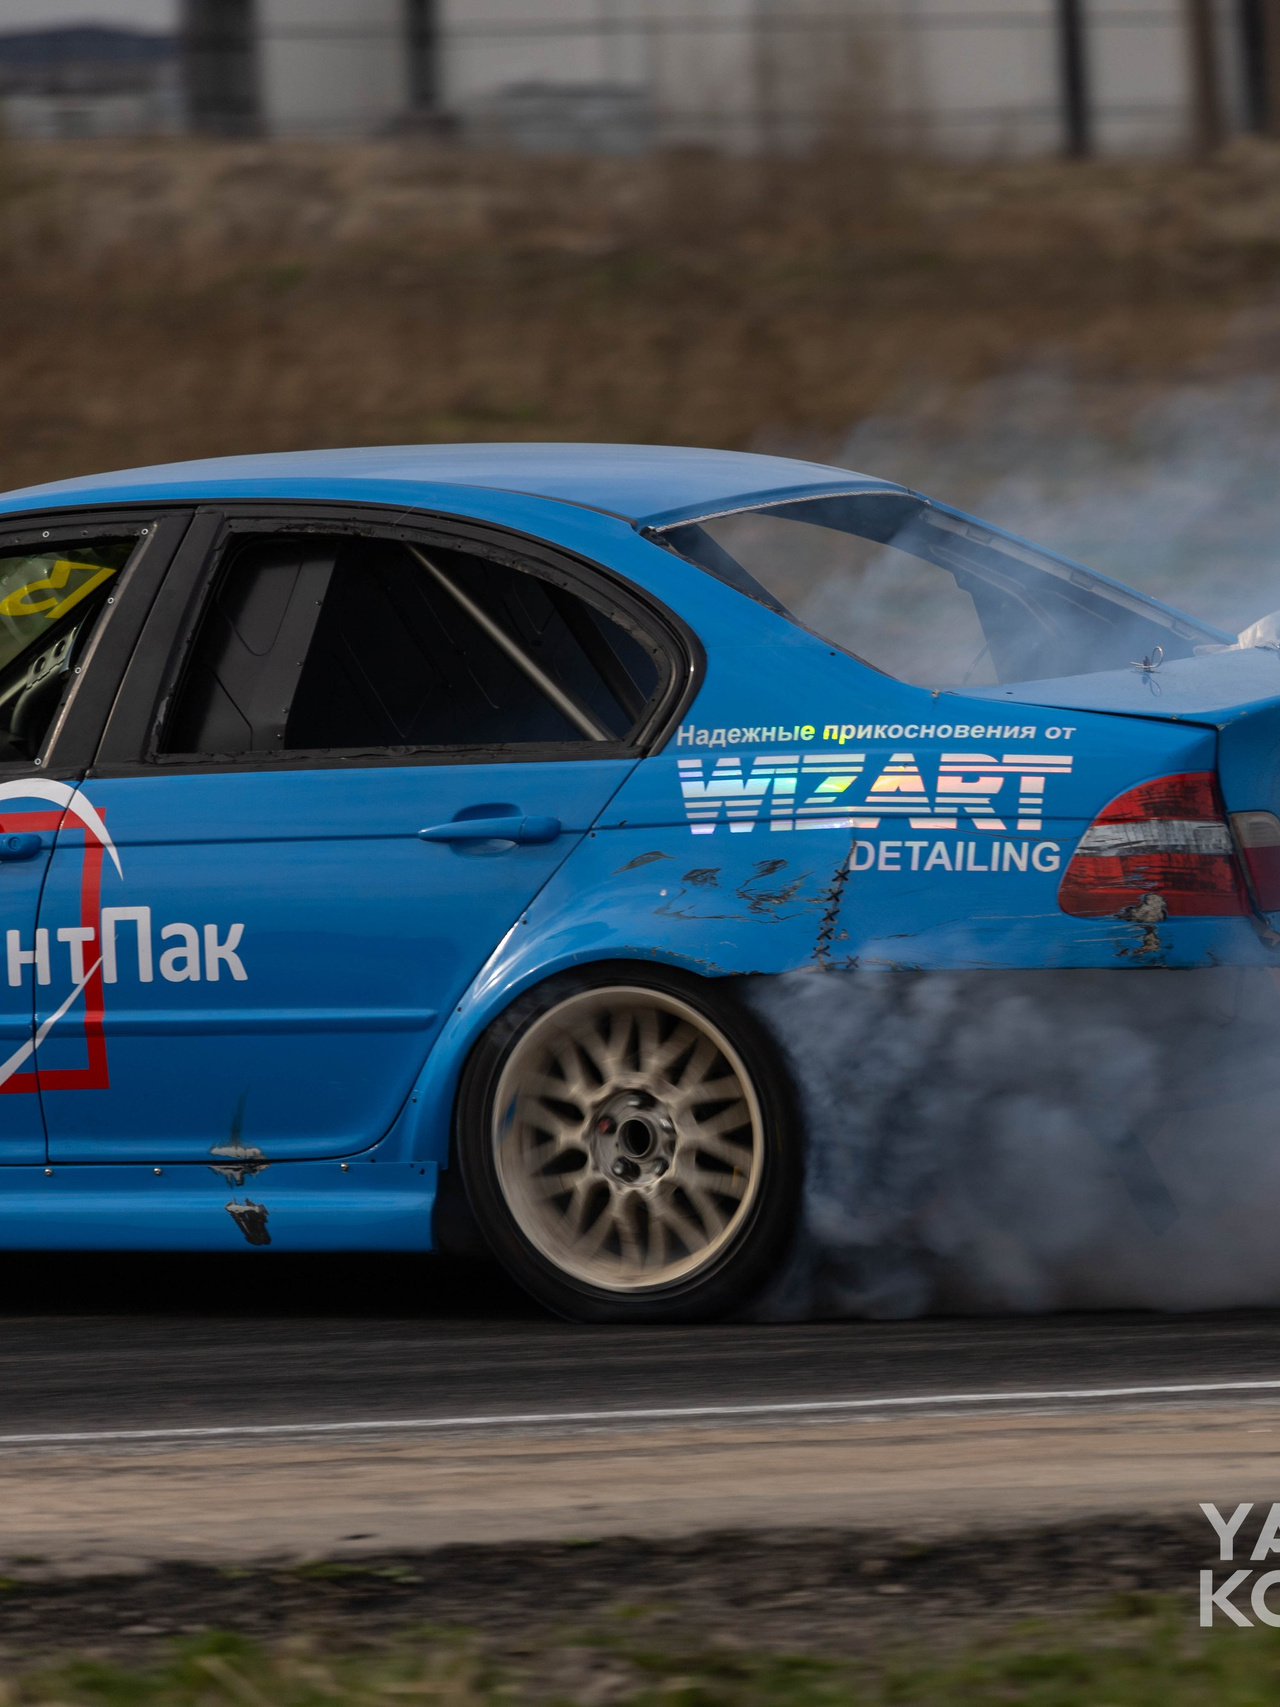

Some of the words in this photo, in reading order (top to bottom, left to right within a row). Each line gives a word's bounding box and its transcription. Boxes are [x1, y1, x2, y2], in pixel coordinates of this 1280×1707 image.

[676, 725, 815, 746] Надежные
[823, 721, 1036, 744] прикосновения
[1045, 725, 1076, 741] от
[677, 752, 1074, 835] WIZART
[848, 840, 1061, 873] DETAILING
[6, 905, 248, 987] нтПак
